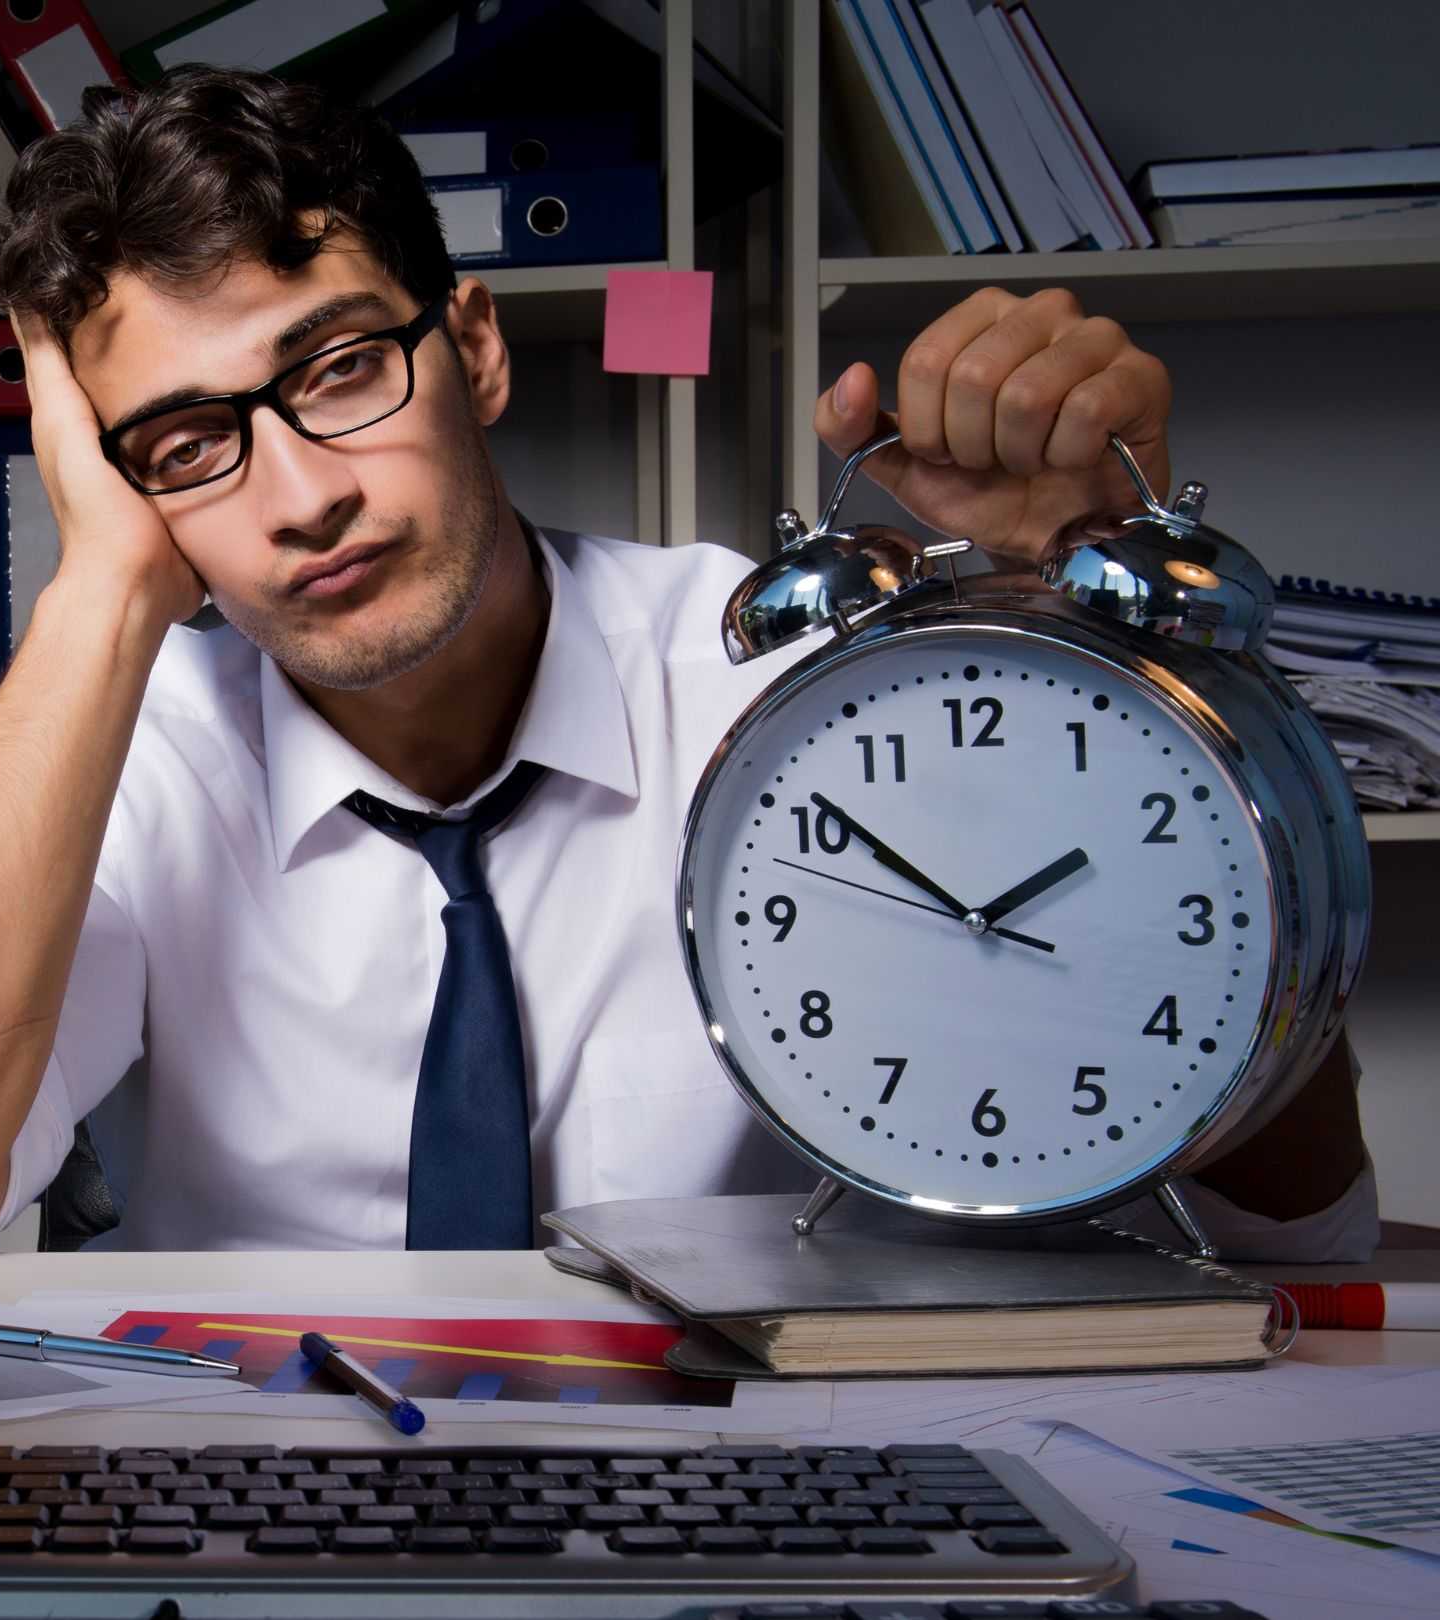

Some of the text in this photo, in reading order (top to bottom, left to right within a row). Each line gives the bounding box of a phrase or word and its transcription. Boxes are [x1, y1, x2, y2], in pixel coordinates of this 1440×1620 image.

[943, 697, 1005, 748] 12
[1066, 721, 1087, 772] 1
[855, 734, 906, 783] 11
[790, 806, 850, 854] 10
[1141, 792, 1178, 844] 2
[764, 895, 797, 943] 9
[1178, 894, 1216, 946] 3
[800, 990, 833, 1039] 8
[1141, 994, 1184, 1046] 4
[873, 1057, 909, 1105] 7
[1072, 1066, 1107, 1116] 5
[971, 1088, 1007, 1138] 6
